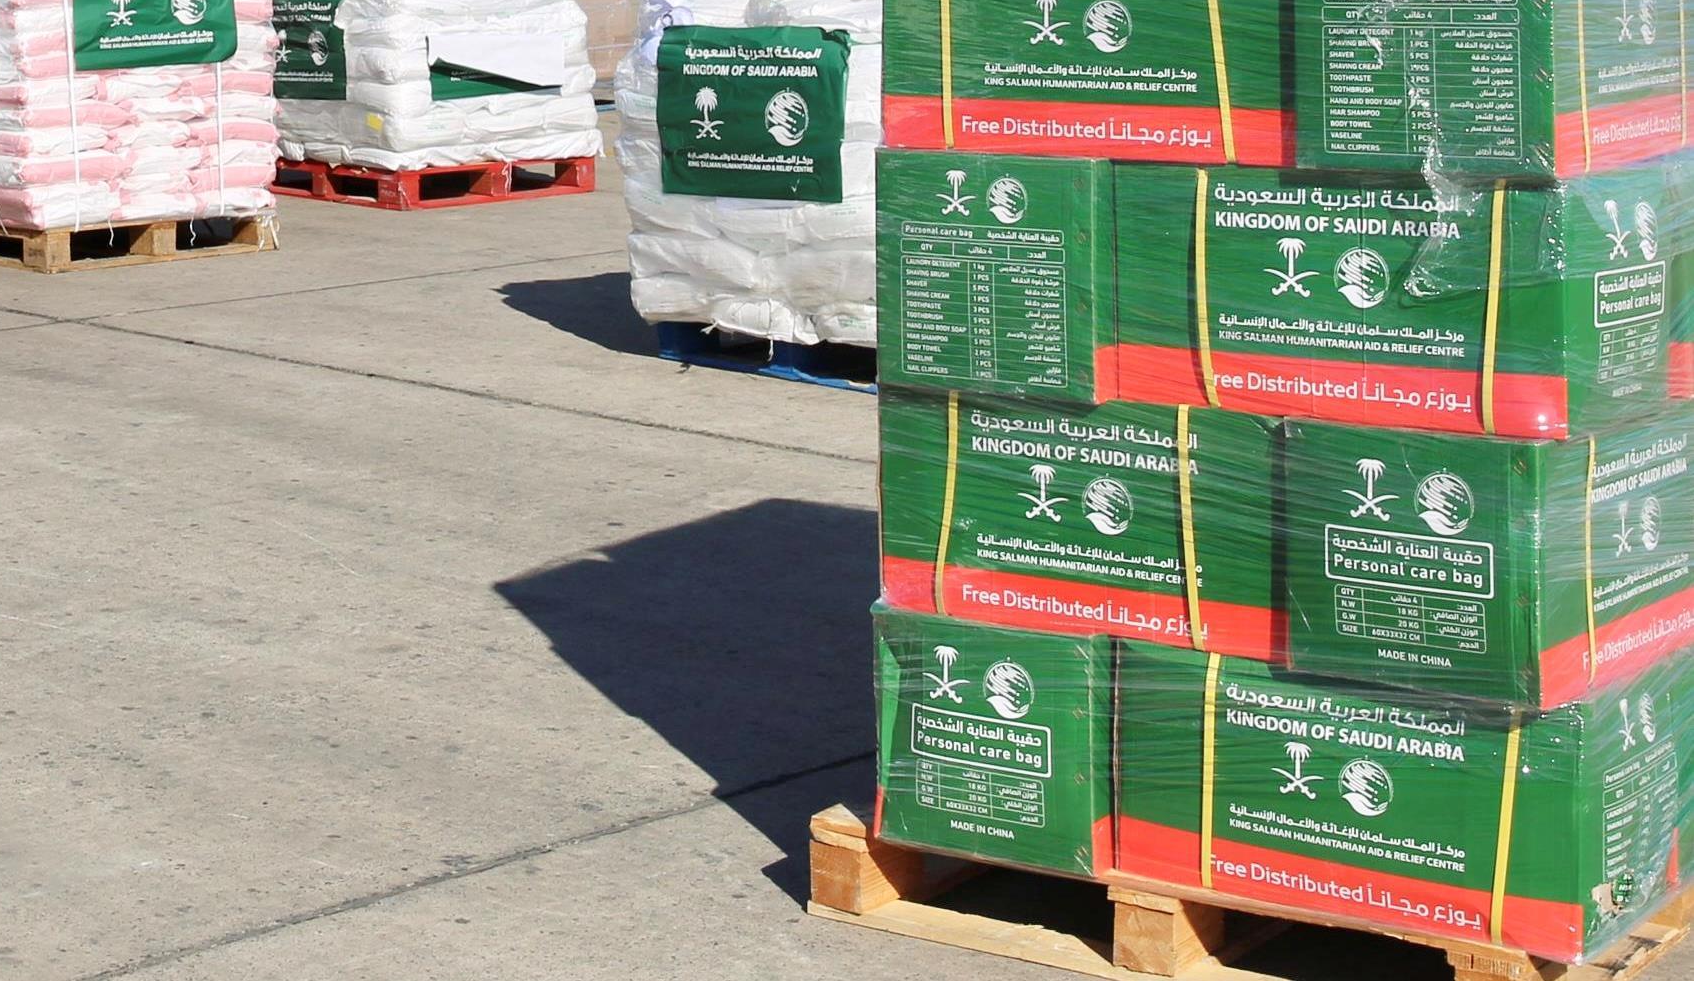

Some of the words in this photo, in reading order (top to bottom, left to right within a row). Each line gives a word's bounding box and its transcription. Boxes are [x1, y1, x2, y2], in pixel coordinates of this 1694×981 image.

[683, 64, 730, 76] KINGDOM
[731, 65, 745, 76] OF
[747, 65, 778, 76] SAUDI
[779, 66, 818, 77] ARABIA
[984, 77, 1004, 85] KING
[1006, 78, 1041, 87] SALMAN
[1043, 79, 1108, 89] HUMANITARIAN
[1110, 82, 1125, 90] AID
[1126, 82, 1132, 90] &
[1133, 82, 1161, 91] RELIEF
[1163, 83, 1197, 92] CENTRE
[962, 116, 1000, 134] Free
[1004, 118, 1106, 139] Distributed
[1215, 183, 1306, 206] السعودية
[1311, 188, 1375, 210] العربية
[1216, 211, 1301, 230] KINGDOM
[1305, 216, 1329, 232] OF
[1334, 217, 1386, 235] SAUDI
[1391, 221, 1461, 239] ARABIA
[1600, 297, 1633, 314] Personal
[1635, 297, 1650, 308] care
[1651, 292, 1662, 306] bag
[1213, 374, 1243, 388] ree
[1248, 372, 1357, 399] Distributed
[971, 410, 1054, 434] السعودية
[1059, 419, 1120, 442] العربية
[1124, 428, 1198, 449] الملكة
[972, 436, 1051, 459] KINGDOM
[1055, 445, 1076, 460] OF
[1080, 448, 1130, 467] SAUDI
[1134, 455, 1199, 475] ARABA
[1591, 478, 1627, 503] KINGDOM
[1628, 475, 1638, 490] OF
[1638, 467, 1662, 487] SAUDI
[1662, 457, 1687, 478] ARABIA
[1332, 534, 1391, 554] الشخصية
[1395, 542, 1438, 559] العناية
[1443, 548, 1482, 564] حقيبة
[1333, 554, 1405, 576] Personal
[1411, 567, 1446, 581] care
[1453, 569, 1482, 588] bag
[963, 584, 1000, 605] Free
[1003, 590, 1104, 620] Distributed
[1378, 649, 1406, 661] MADE
[1408, 653, 1418, 662] IN
[1421, 655, 1451, 667] CHINA
[1226, 683, 1315, 712] السعودية
[1318, 697, 1384, 723] العربية
[917, 712, 963, 734] الشخصية
[967, 723, 1003, 740] العناية
[1387, 707, 1465, 737] المملكة
[1007, 730, 1041, 746] حقيبة
[1227, 709, 1307, 737] KINGDOM
[1311, 724, 1335, 740] OF
[1339, 728, 1392, 750] SAUDI
[1396, 737, 1464, 761] ARABIA
[918, 731, 975, 754] Personal
[980, 747, 1010, 760] care
[1016, 749, 1042, 767] bag
[951, 820, 975, 832] MADE
[977, 825, 986, 833] IN
[987, 827, 1014, 839] CHINA
[1230, 818, 1251, 830] KING
[1253, 823, 1292, 838] SALMAN
[1293, 832, 1366, 853] HUMANITARIAN
[1367, 847, 1384, 857] AID
[1385, 850, 1392, 859] &
[1394, 851, 1425, 864] RELIEF
[1426, 858, 1465, 872] CENTRE
[1250, 863, 1363, 902] Distributed
